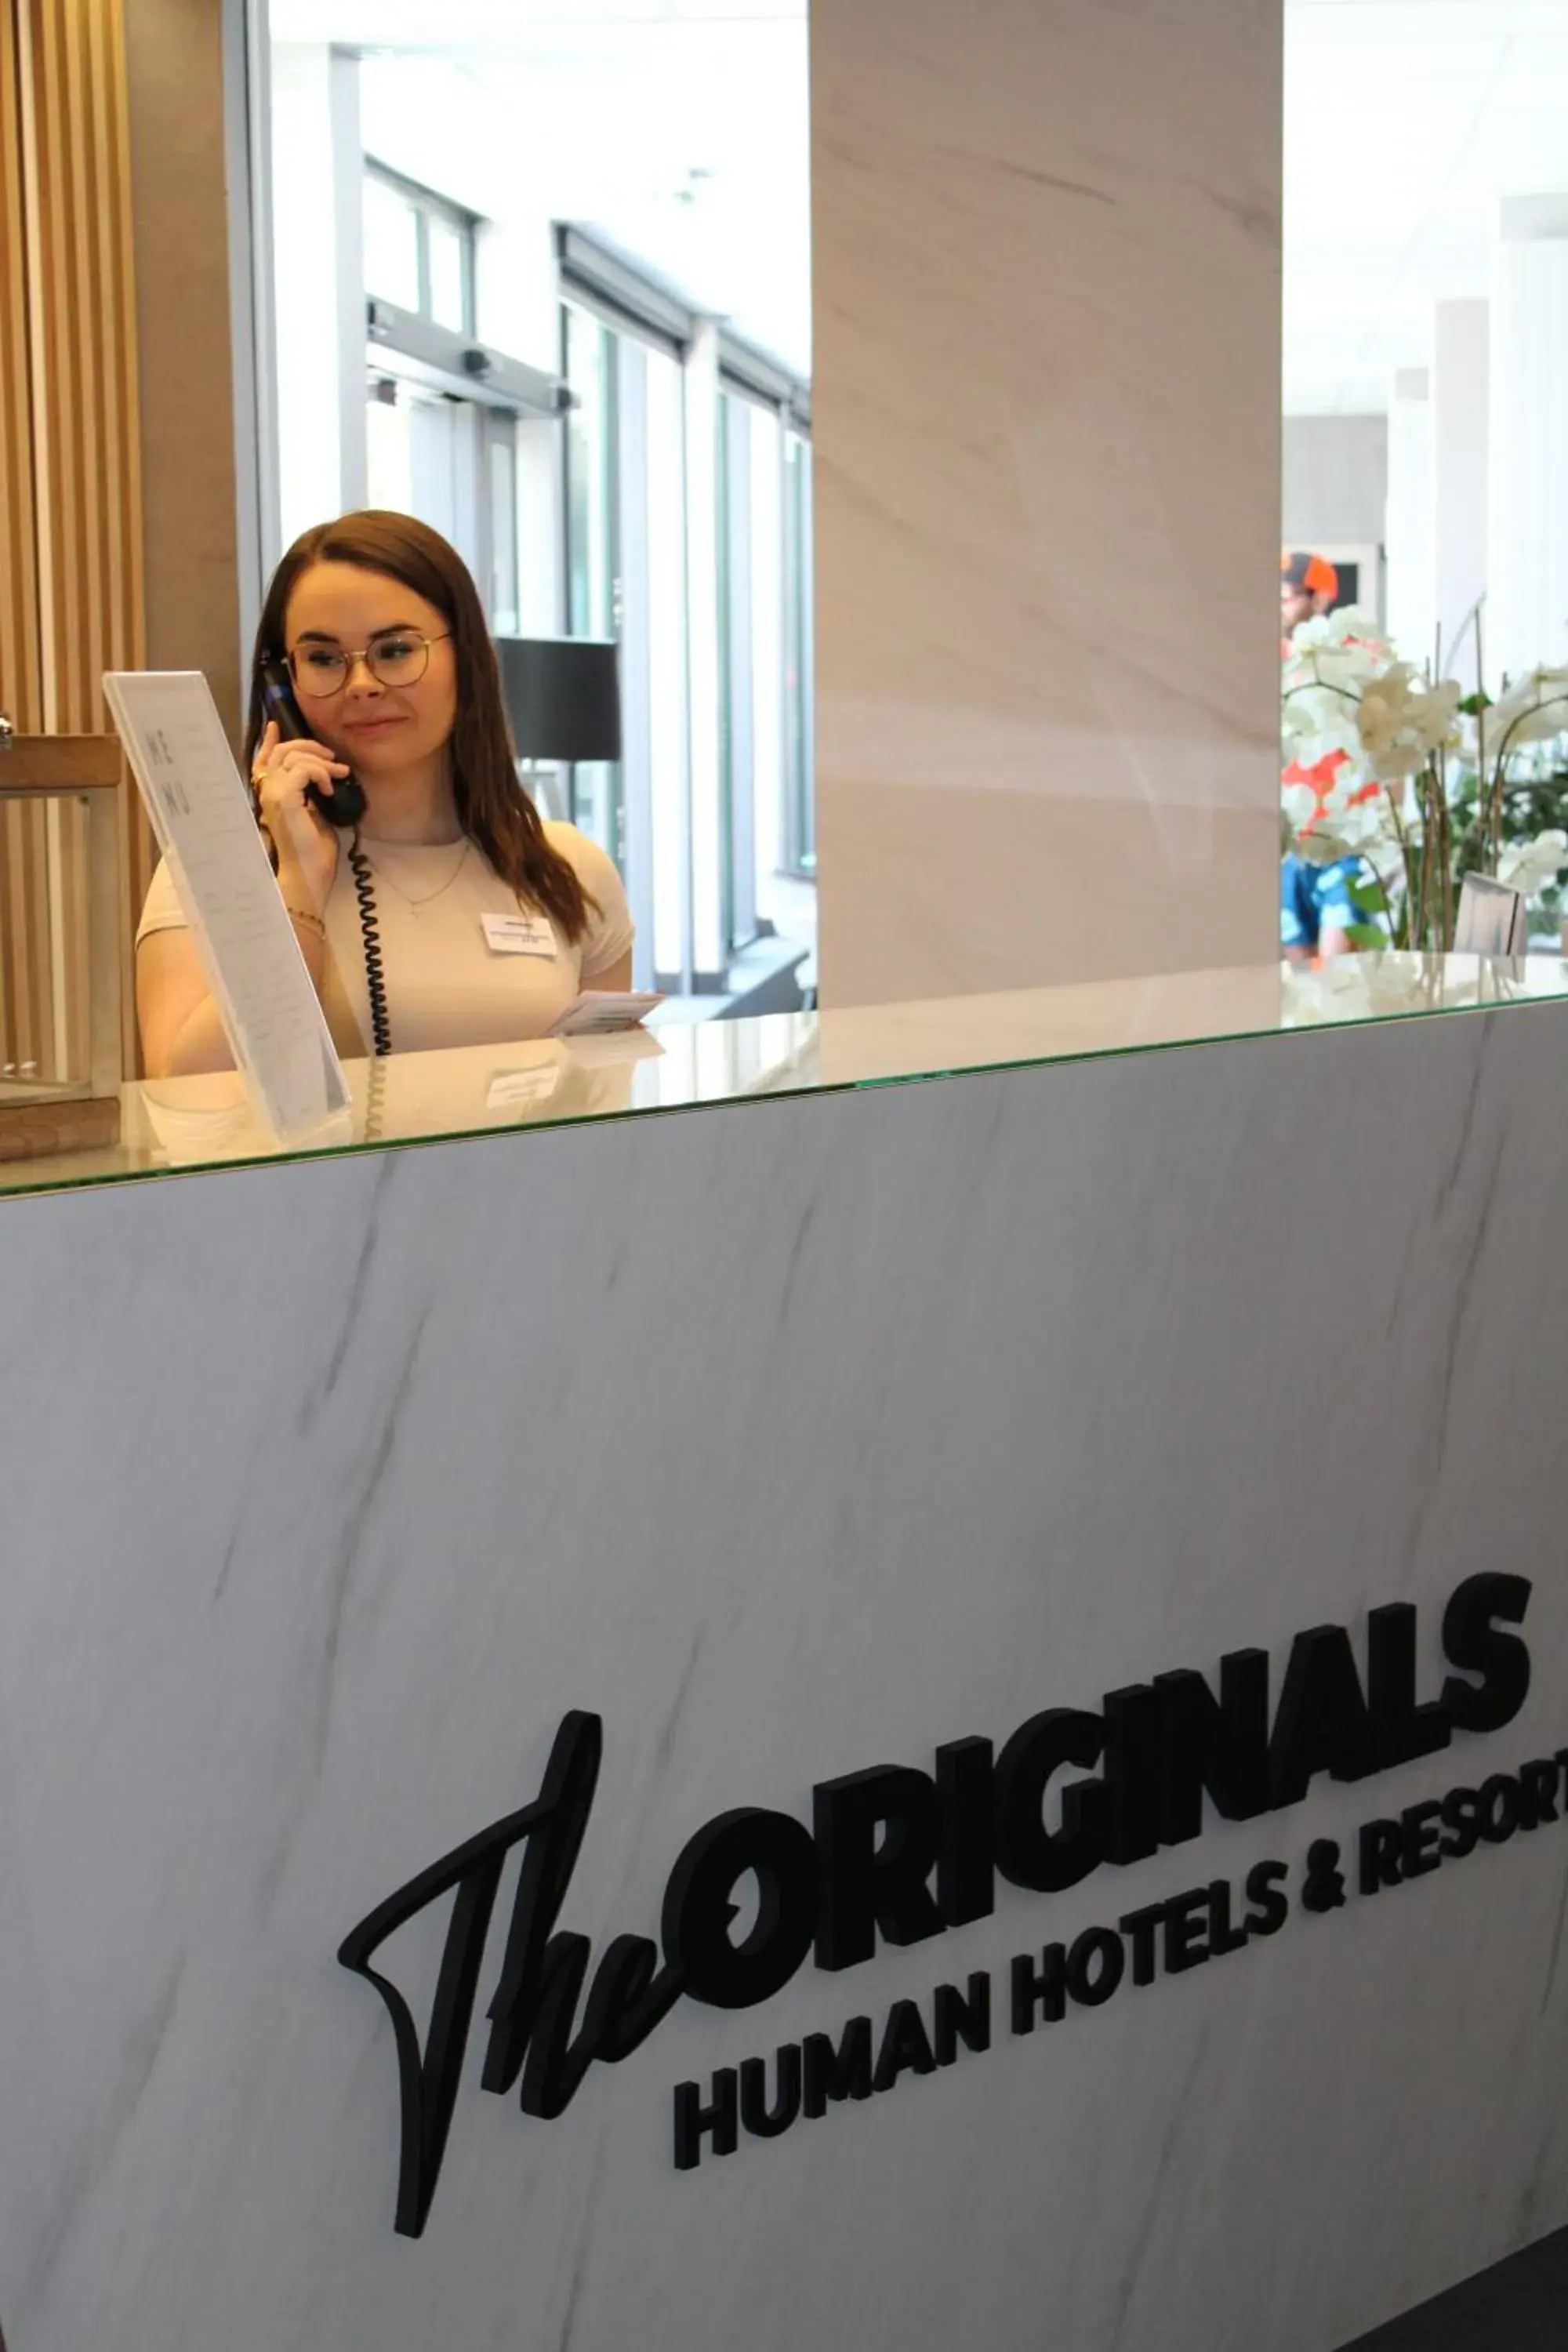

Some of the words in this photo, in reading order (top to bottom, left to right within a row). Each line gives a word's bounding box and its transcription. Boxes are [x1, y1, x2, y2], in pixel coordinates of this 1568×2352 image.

[338, 1709, 685, 2238] The
[661, 1572, 1532, 2009] ORIGINALS
[675, 1971, 990, 2171] HUMAN
[1012, 1860, 1288, 2035] HOTELS
[1302, 1838, 1347, 1913] &
